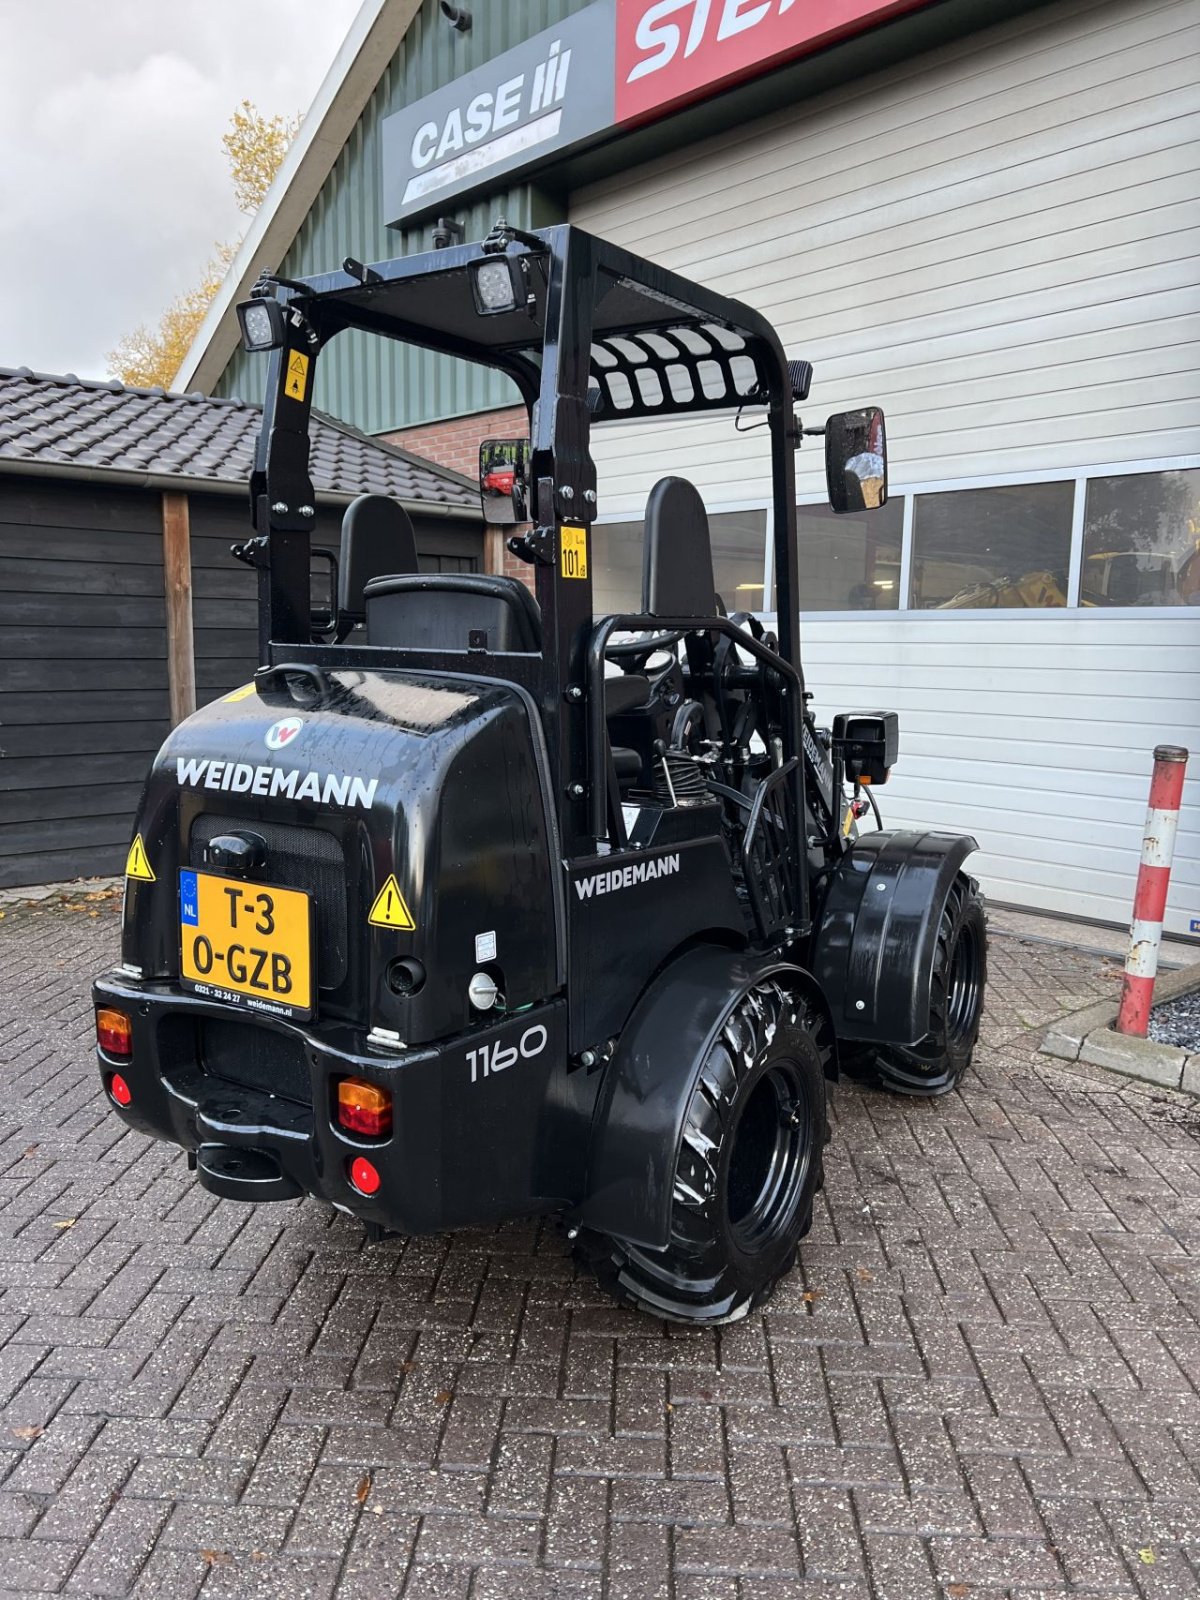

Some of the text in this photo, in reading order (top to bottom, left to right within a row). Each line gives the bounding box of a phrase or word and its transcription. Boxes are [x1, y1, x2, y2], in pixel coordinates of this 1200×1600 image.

[626, 0, 796, 84] STE
[411, 74, 524, 169] CASE
[563, 549, 579, 576] 101
[176, 757, 379, 809] WEIDEMANN
[575, 853, 680, 900] WEIDEMANN
[184, 903, 196, 918] NL
[224, 887, 275, 935] T-3
[247, 1000, 292, 1016] weidemann.nl
[466, 1024, 548, 1083] 1160
